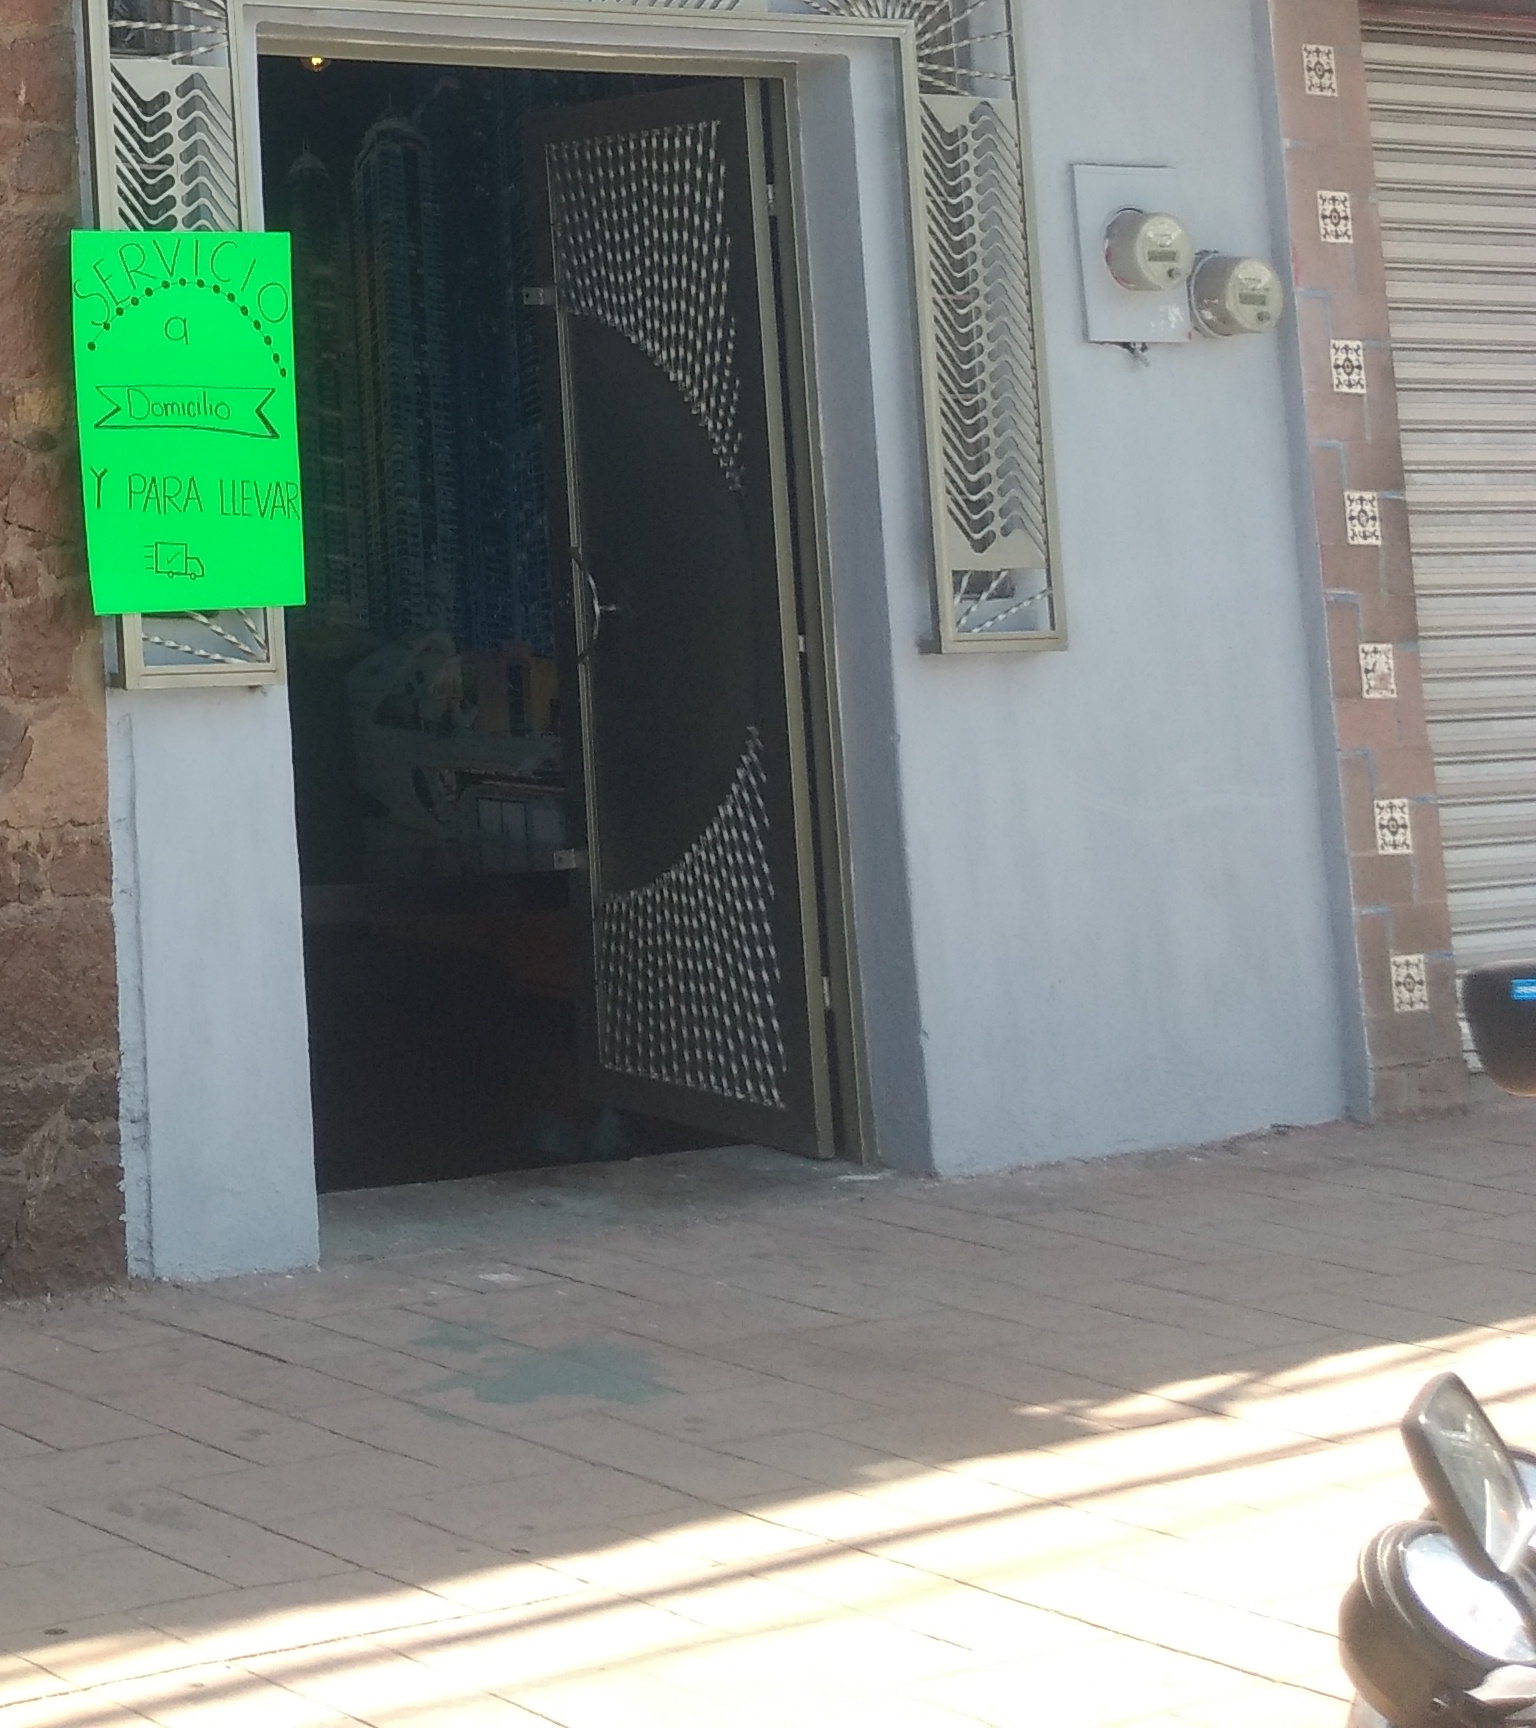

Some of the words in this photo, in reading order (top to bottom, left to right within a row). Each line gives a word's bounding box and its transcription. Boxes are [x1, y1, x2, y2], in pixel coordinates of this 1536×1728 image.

[72, 238, 289, 327] SERVICIO
[125, 387, 232, 421] Domicilio
[89, 466, 109, 510] Y
[127, 472, 204, 515] PARA
[219, 478, 301, 520] LLEVAR
